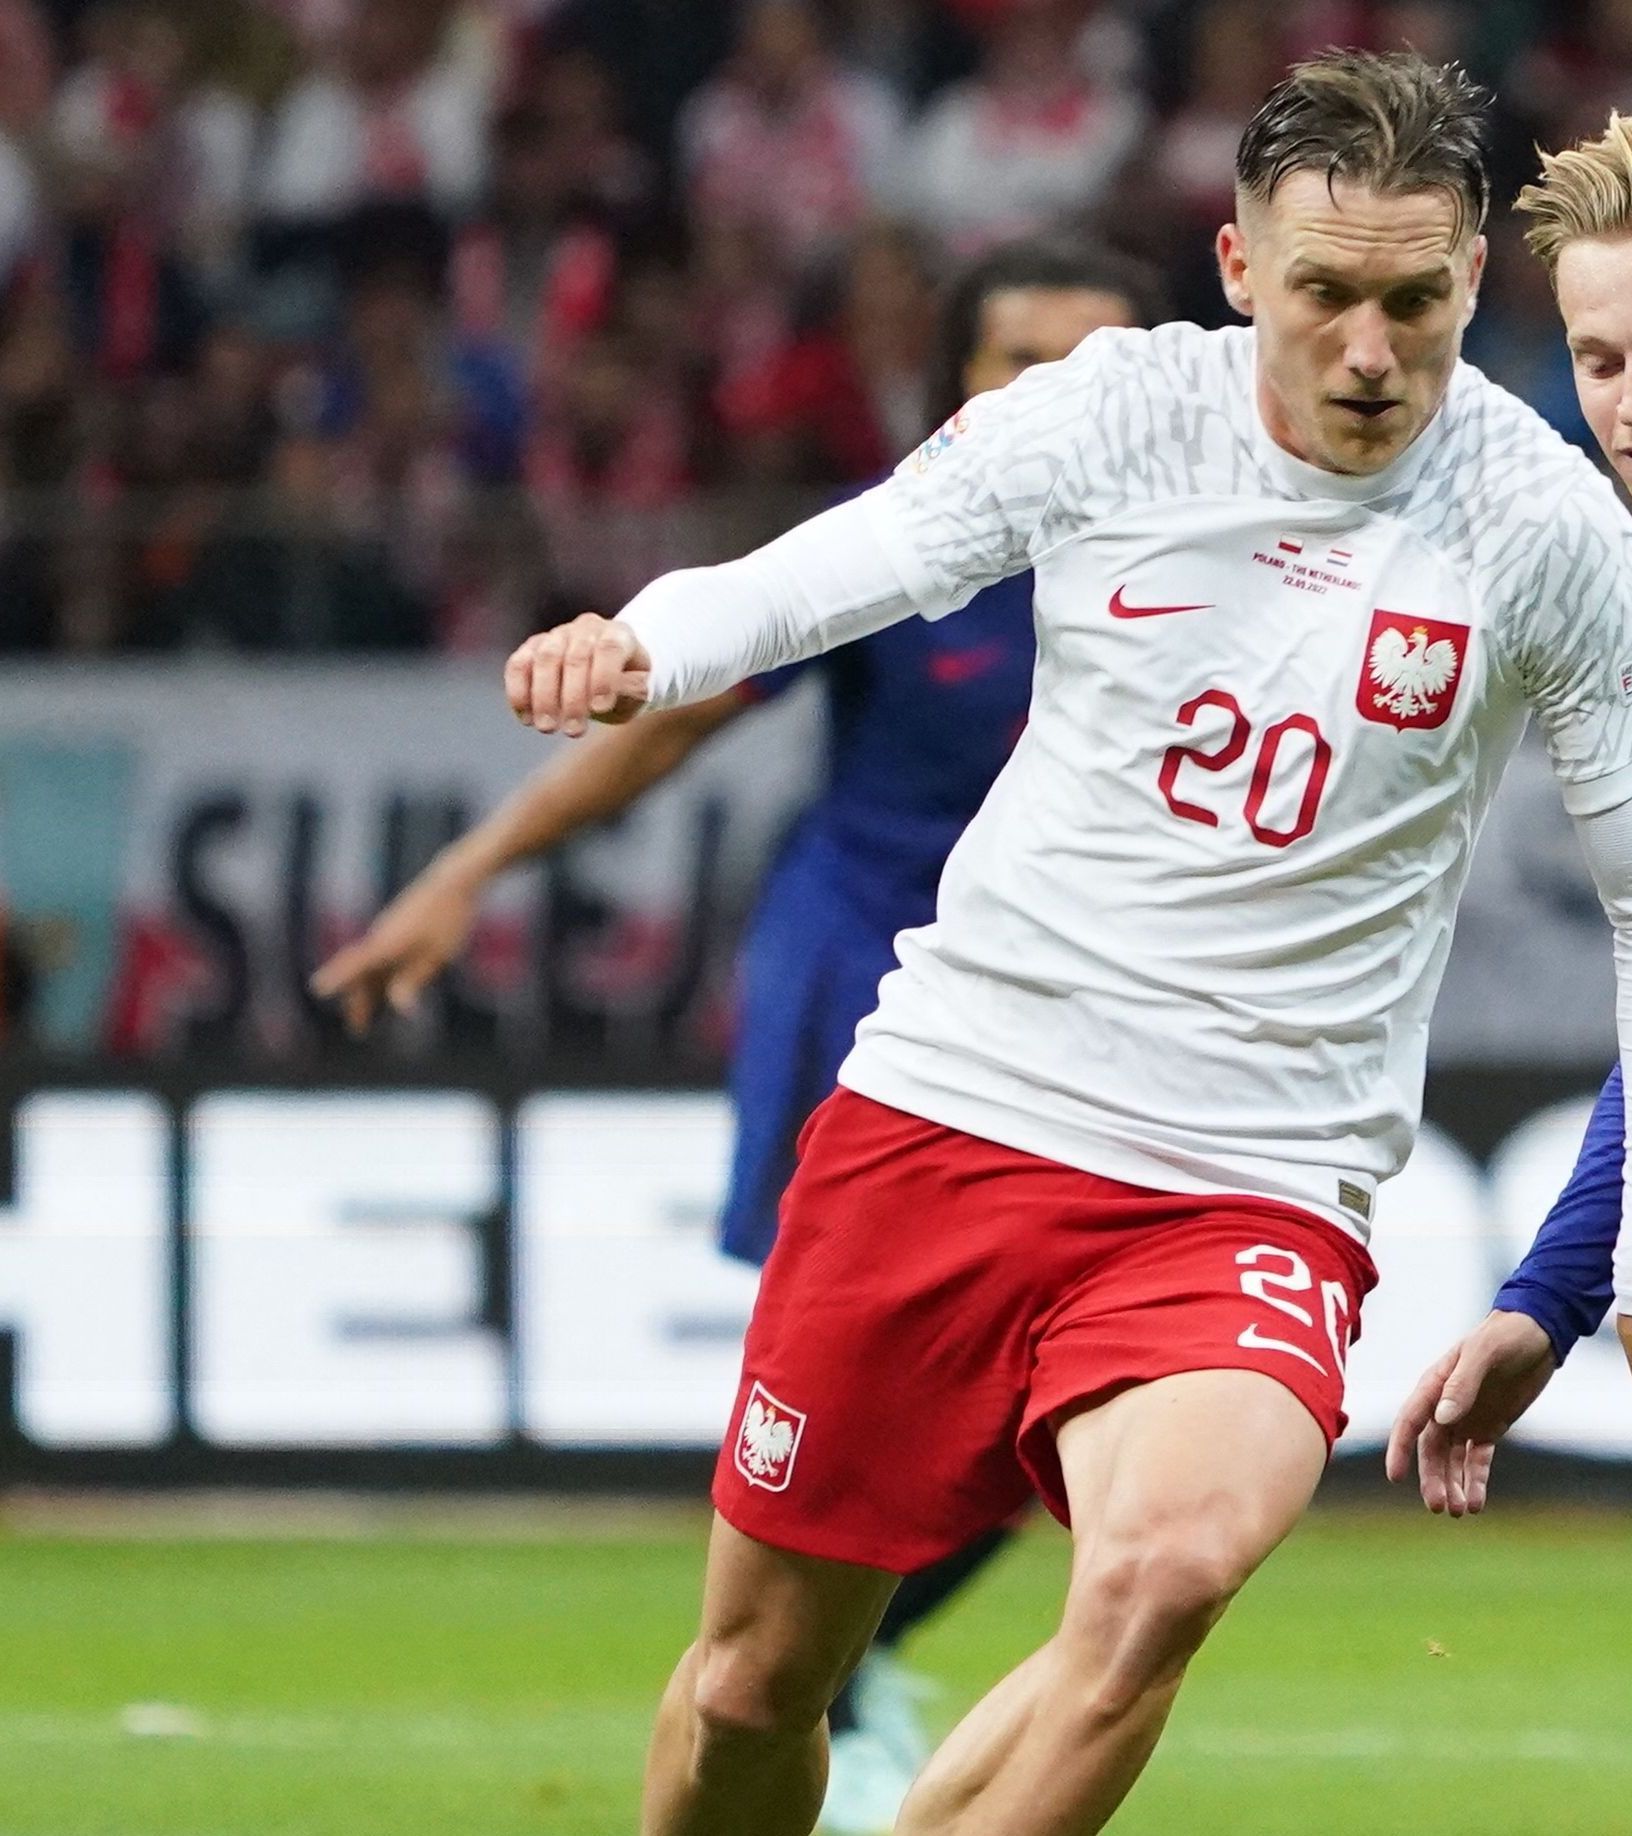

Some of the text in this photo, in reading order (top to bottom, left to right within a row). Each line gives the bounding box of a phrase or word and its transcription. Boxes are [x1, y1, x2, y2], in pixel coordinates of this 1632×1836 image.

[1252, 552, 1286, 569] POLAND
[1291, 563, 1308, 577] THE
[1157, 688, 1333, 849] 20
